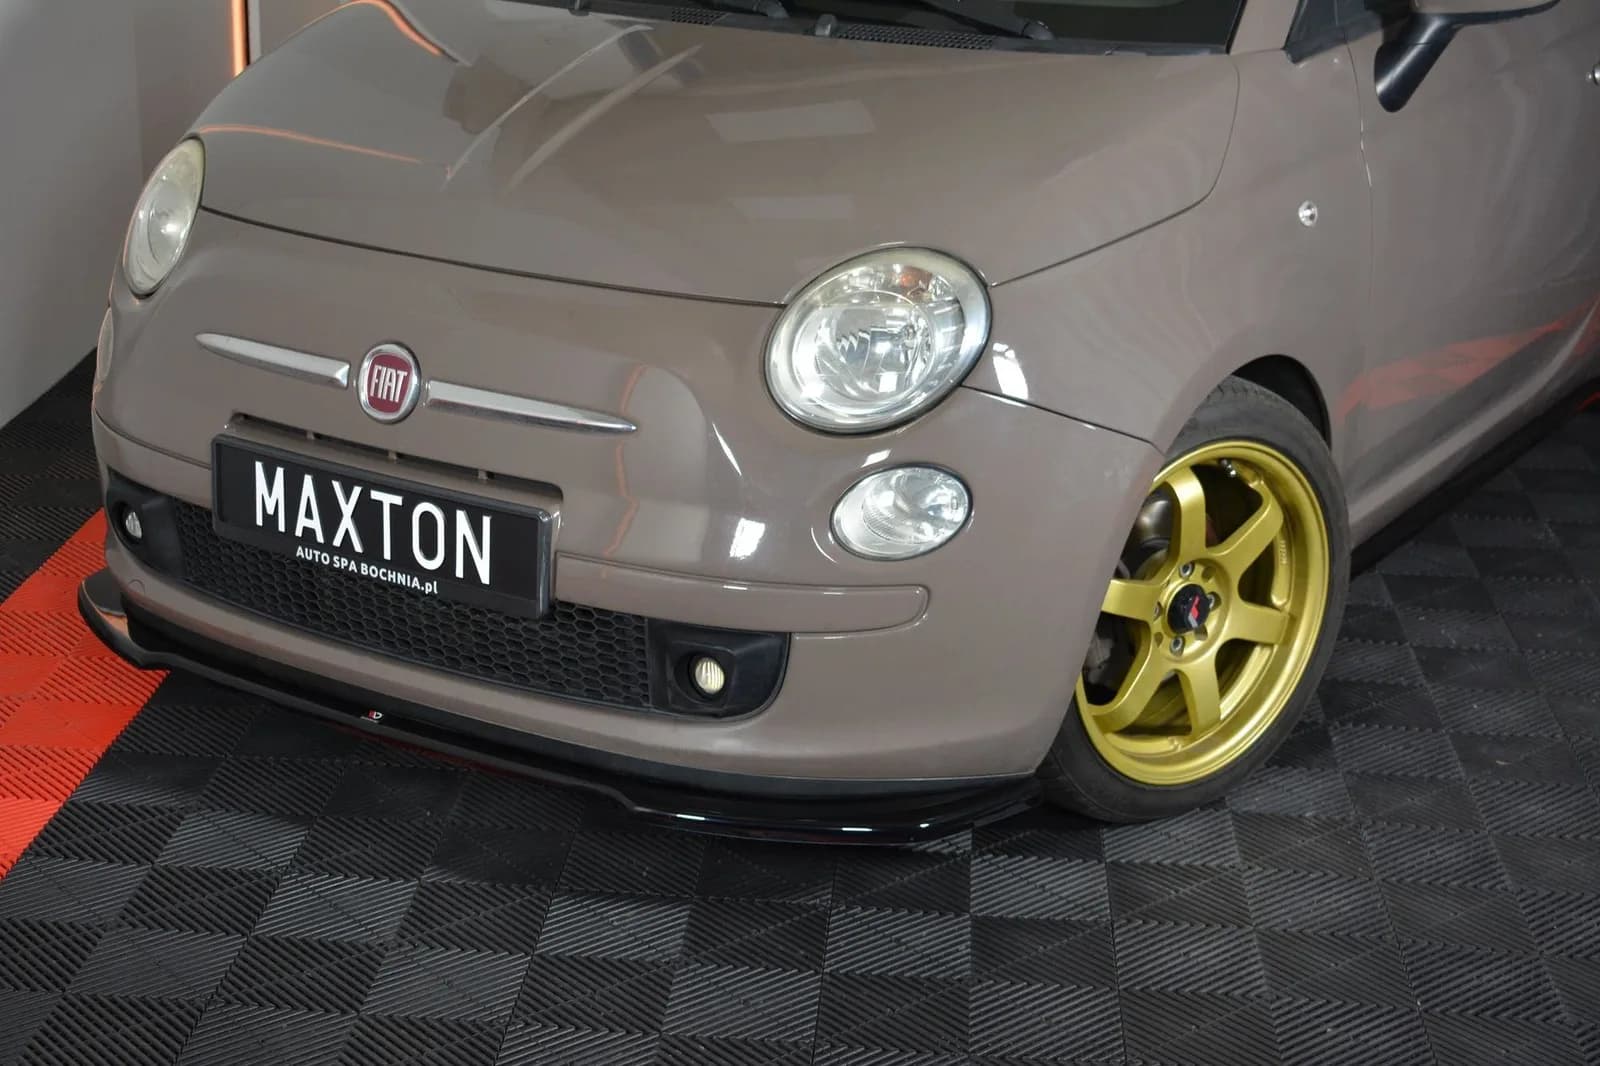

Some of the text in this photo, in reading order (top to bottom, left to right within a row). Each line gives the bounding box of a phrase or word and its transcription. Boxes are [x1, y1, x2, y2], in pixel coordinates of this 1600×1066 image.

[370, 364, 408, 403] FIAT
[254, 460, 492, 585] MAXTON
[296, 545, 438, 595] AUTO SPA BOCHNIA.pl
